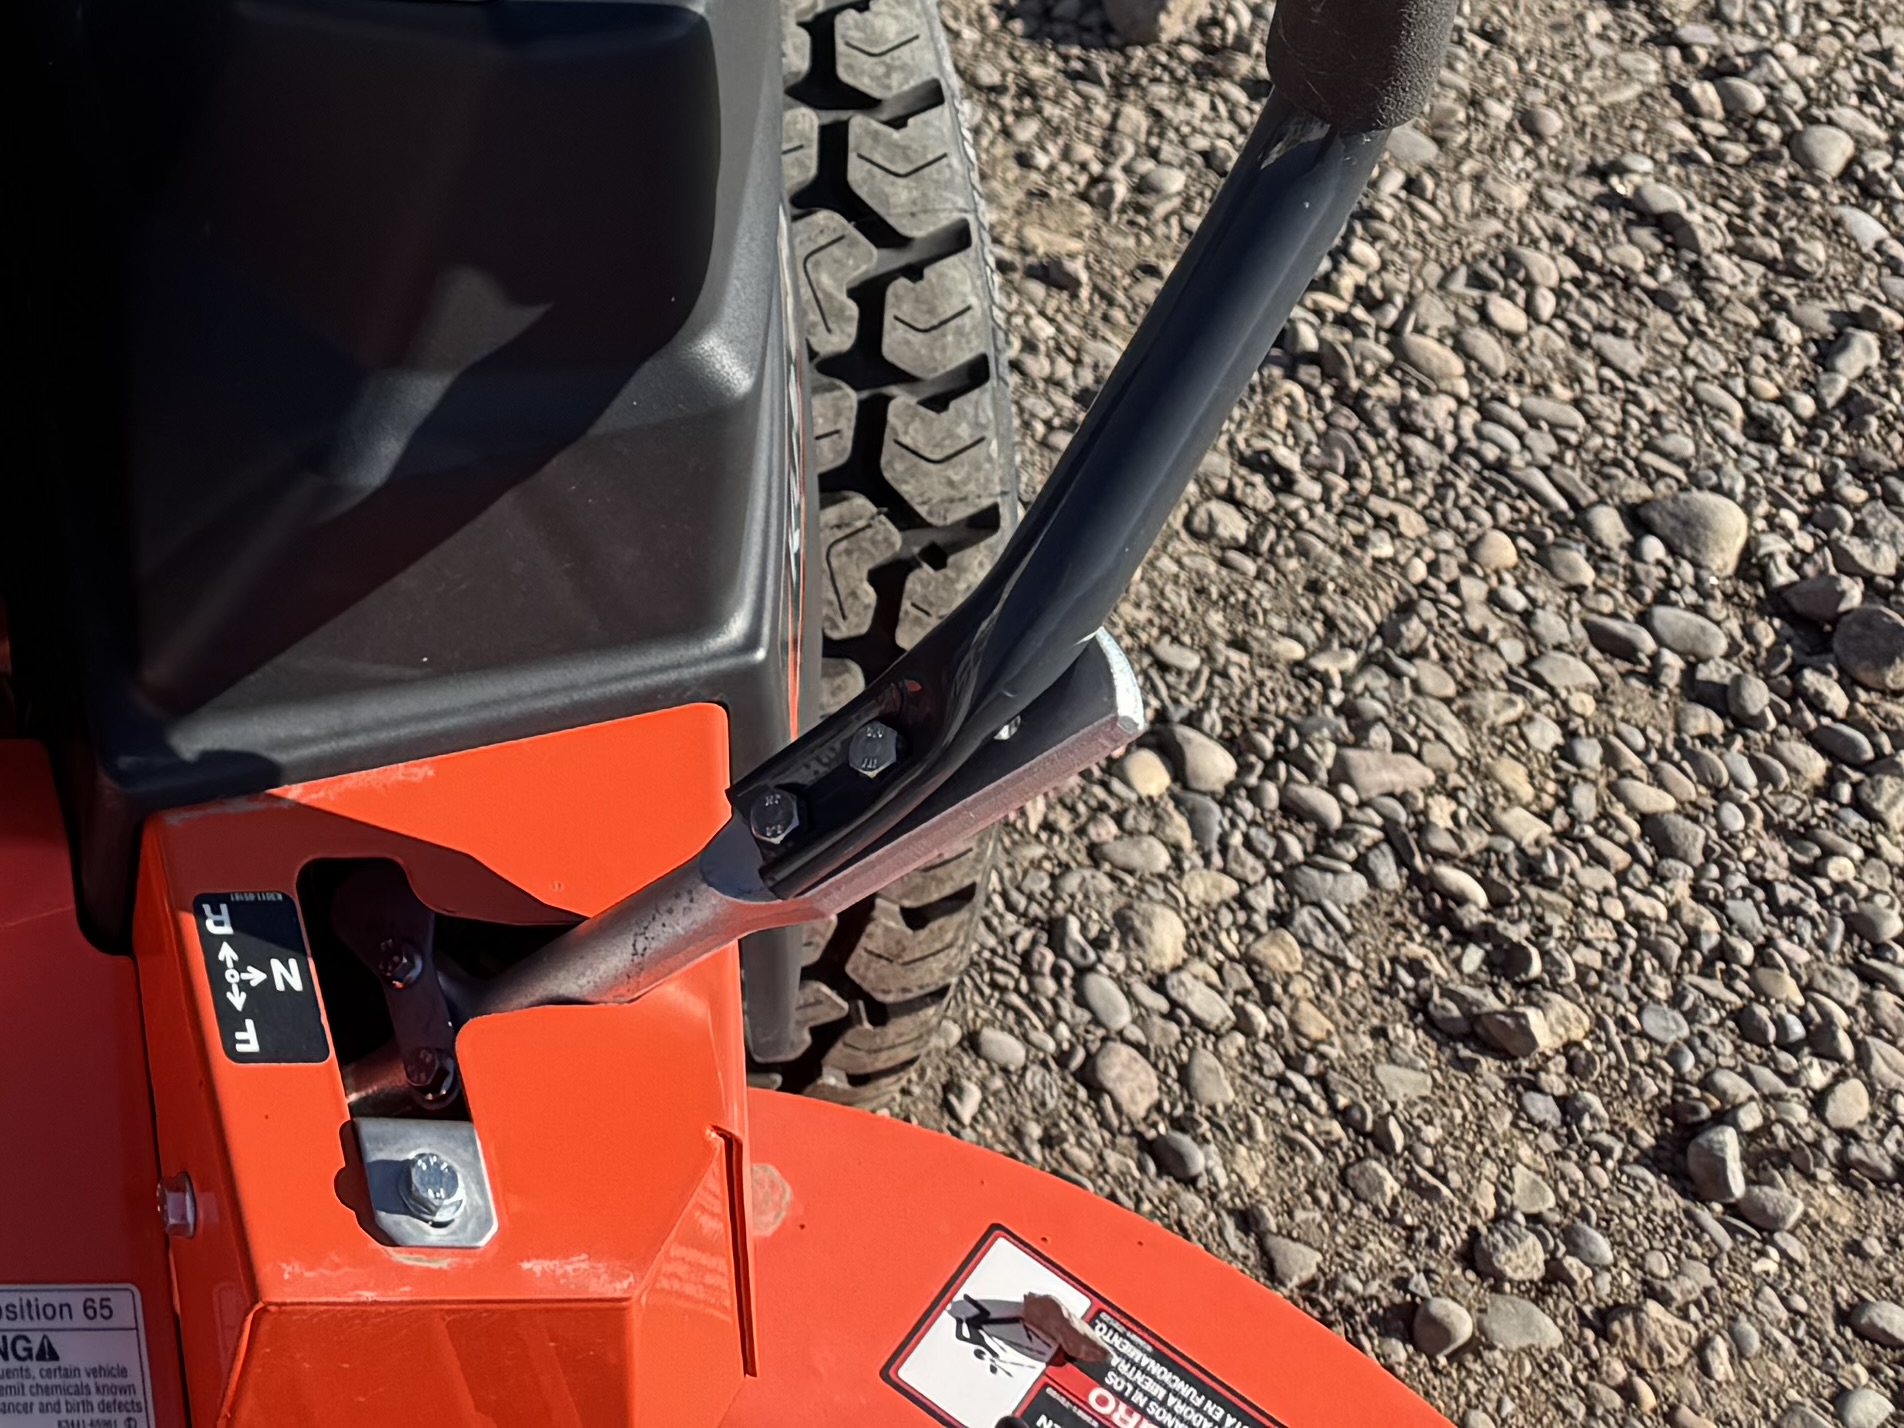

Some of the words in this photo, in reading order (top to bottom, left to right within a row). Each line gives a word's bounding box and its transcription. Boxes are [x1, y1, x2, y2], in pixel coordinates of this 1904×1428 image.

[201, 903, 234, 936] R
[270, 957, 304, 993] N
[234, 1018, 261, 1054] F
[82, 1297, 114, 1320] 65
[38, 1364, 80, 1378] certain
[84, 1364, 128, 1377] vehicle
[1088, 1319, 1207, 1406] FUNCIONAMIENTO.
[1103, 1370, 1135, 1396] LOS
[37, 1399, 61, 1413] and
[64, 1399, 93, 1413] birth
[96, 1399, 142, 1412] defects
[1204, 1400, 1225, 1420] EN
